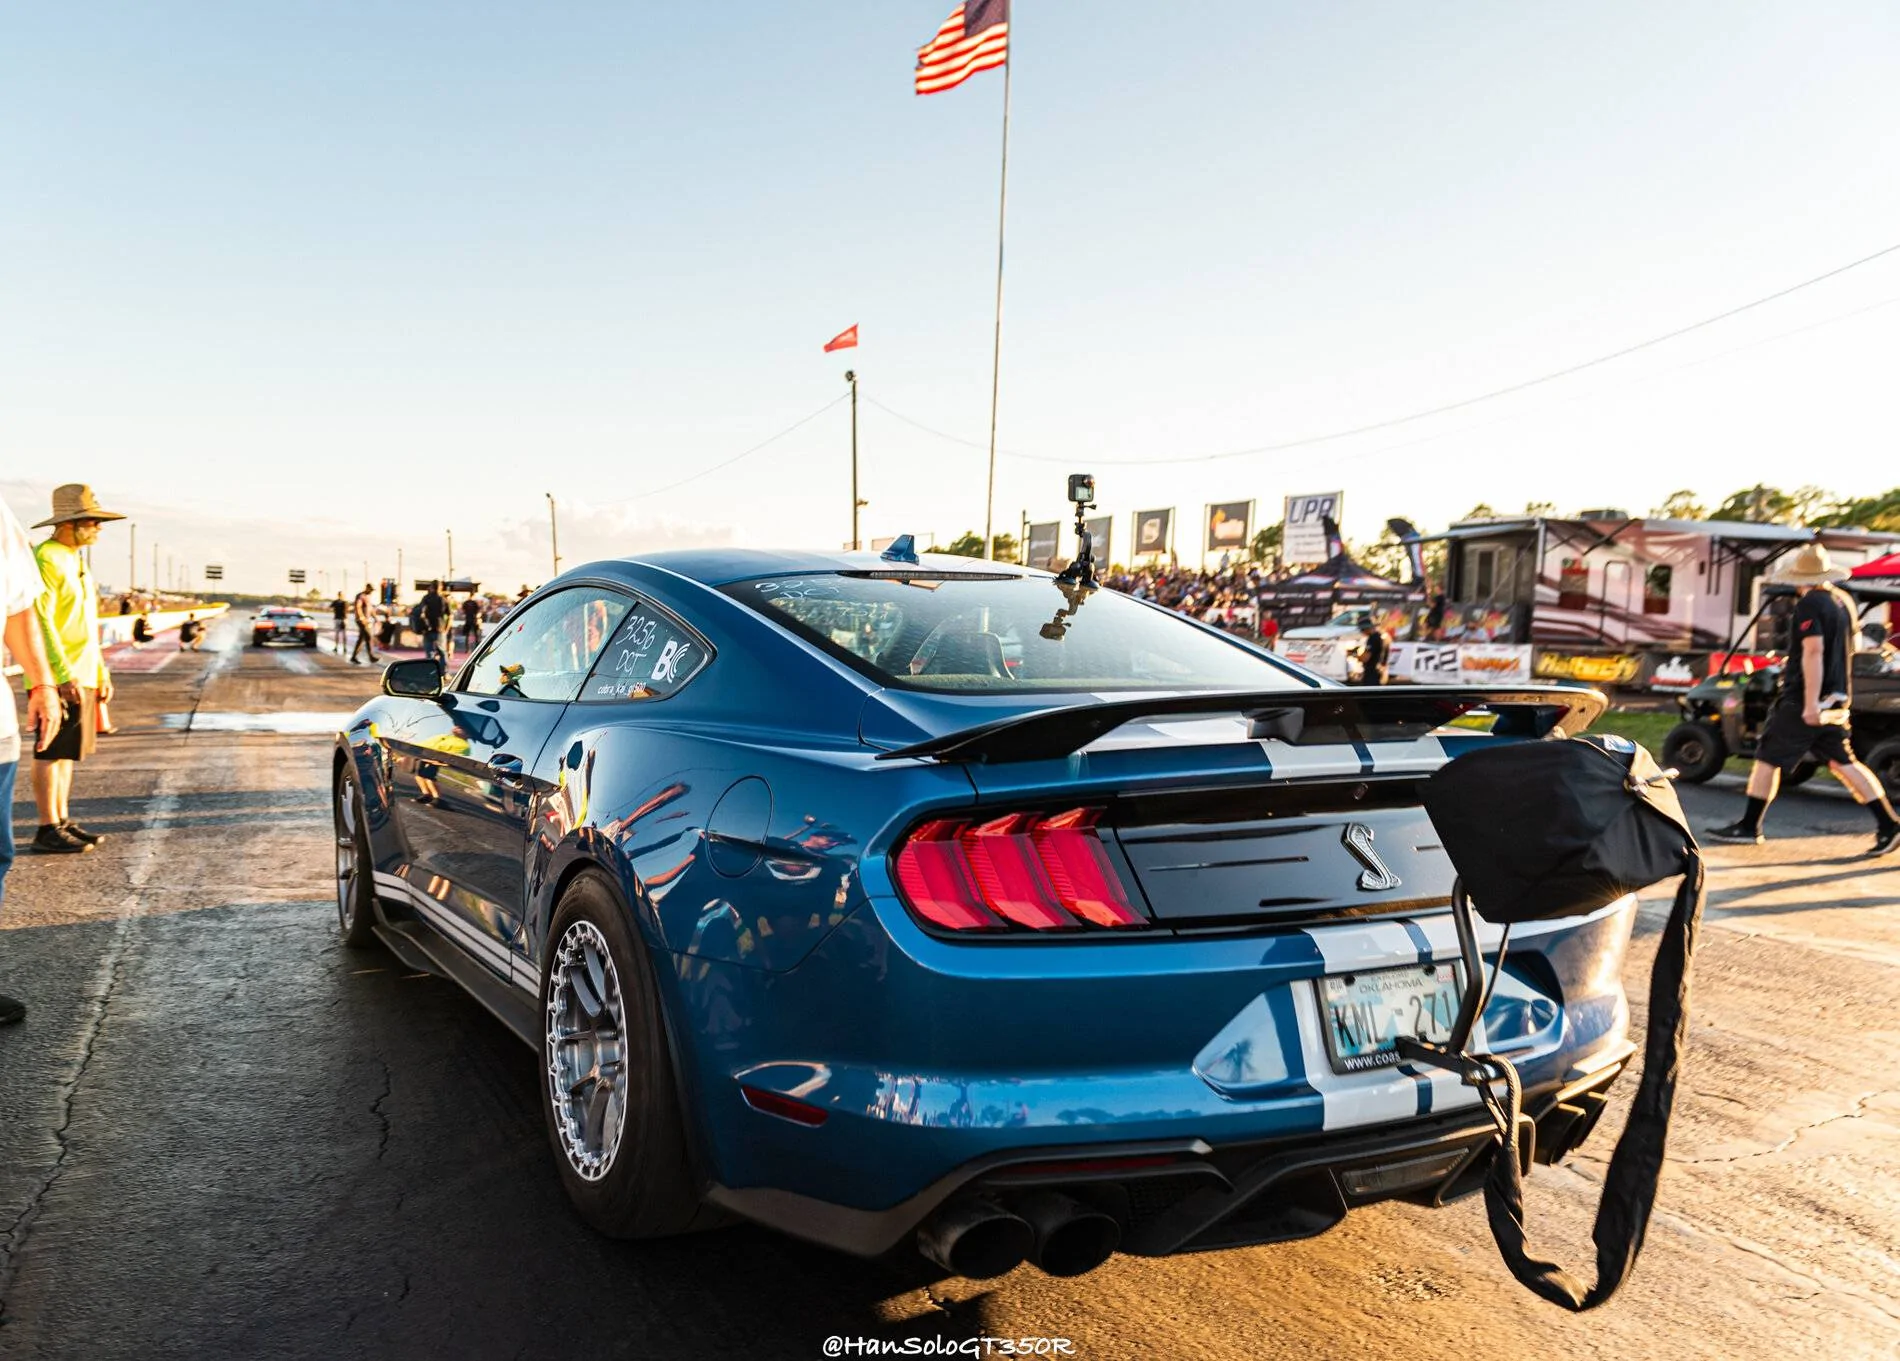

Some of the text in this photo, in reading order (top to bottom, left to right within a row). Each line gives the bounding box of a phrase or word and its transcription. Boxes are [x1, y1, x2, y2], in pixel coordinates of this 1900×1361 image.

[616, 649, 647, 675] DCT
[1359, 978, 1424, 993] OKLAHOMA
[1334, 991, 1453, 1049] KML 271
